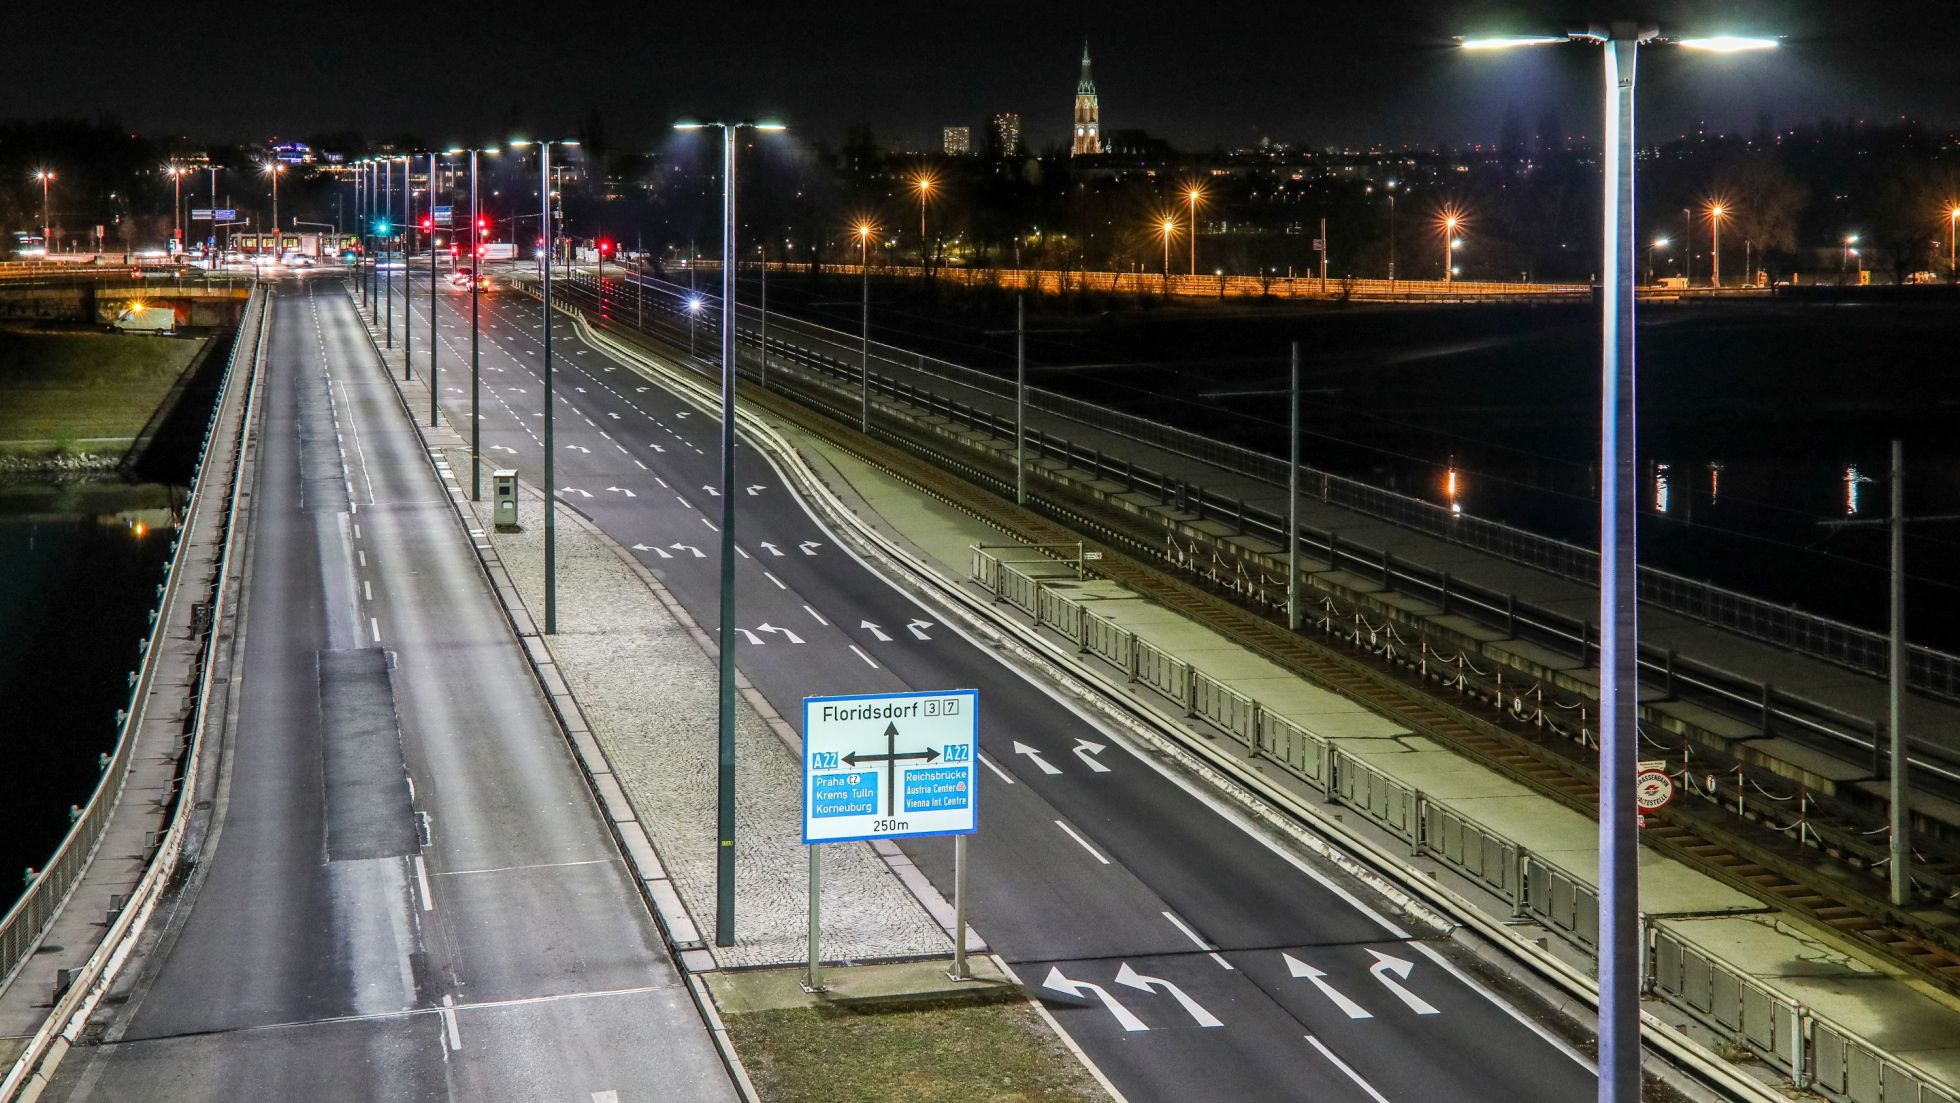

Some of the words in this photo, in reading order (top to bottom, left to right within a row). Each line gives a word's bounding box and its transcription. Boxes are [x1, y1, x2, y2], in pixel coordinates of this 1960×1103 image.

[823, 702, 918, 722] Floridsdorf
[929, 703, 936, 714] 3
[947, 702, 954, 713] 7
[945, 746, 968, 761] A22
[814, 753, 837, 769] A22
[816, 777, 845, 787] Praha
[849, 776, 858, 784] CZ
[906, 770, 967, 782] Reichsbrücke
[816, 791, 848, 801] Krems
[852, 788, 874, 798] Tulln
[907, 784, 931, 794] Austria
[934, 783, 955, 793] Center
[907, 798, 930, 808] Vienna
[944, 796, 967, 806] Centre
[816, 803, 872, 814] Korneuburg
[873, 819, 909, 832] 250m
